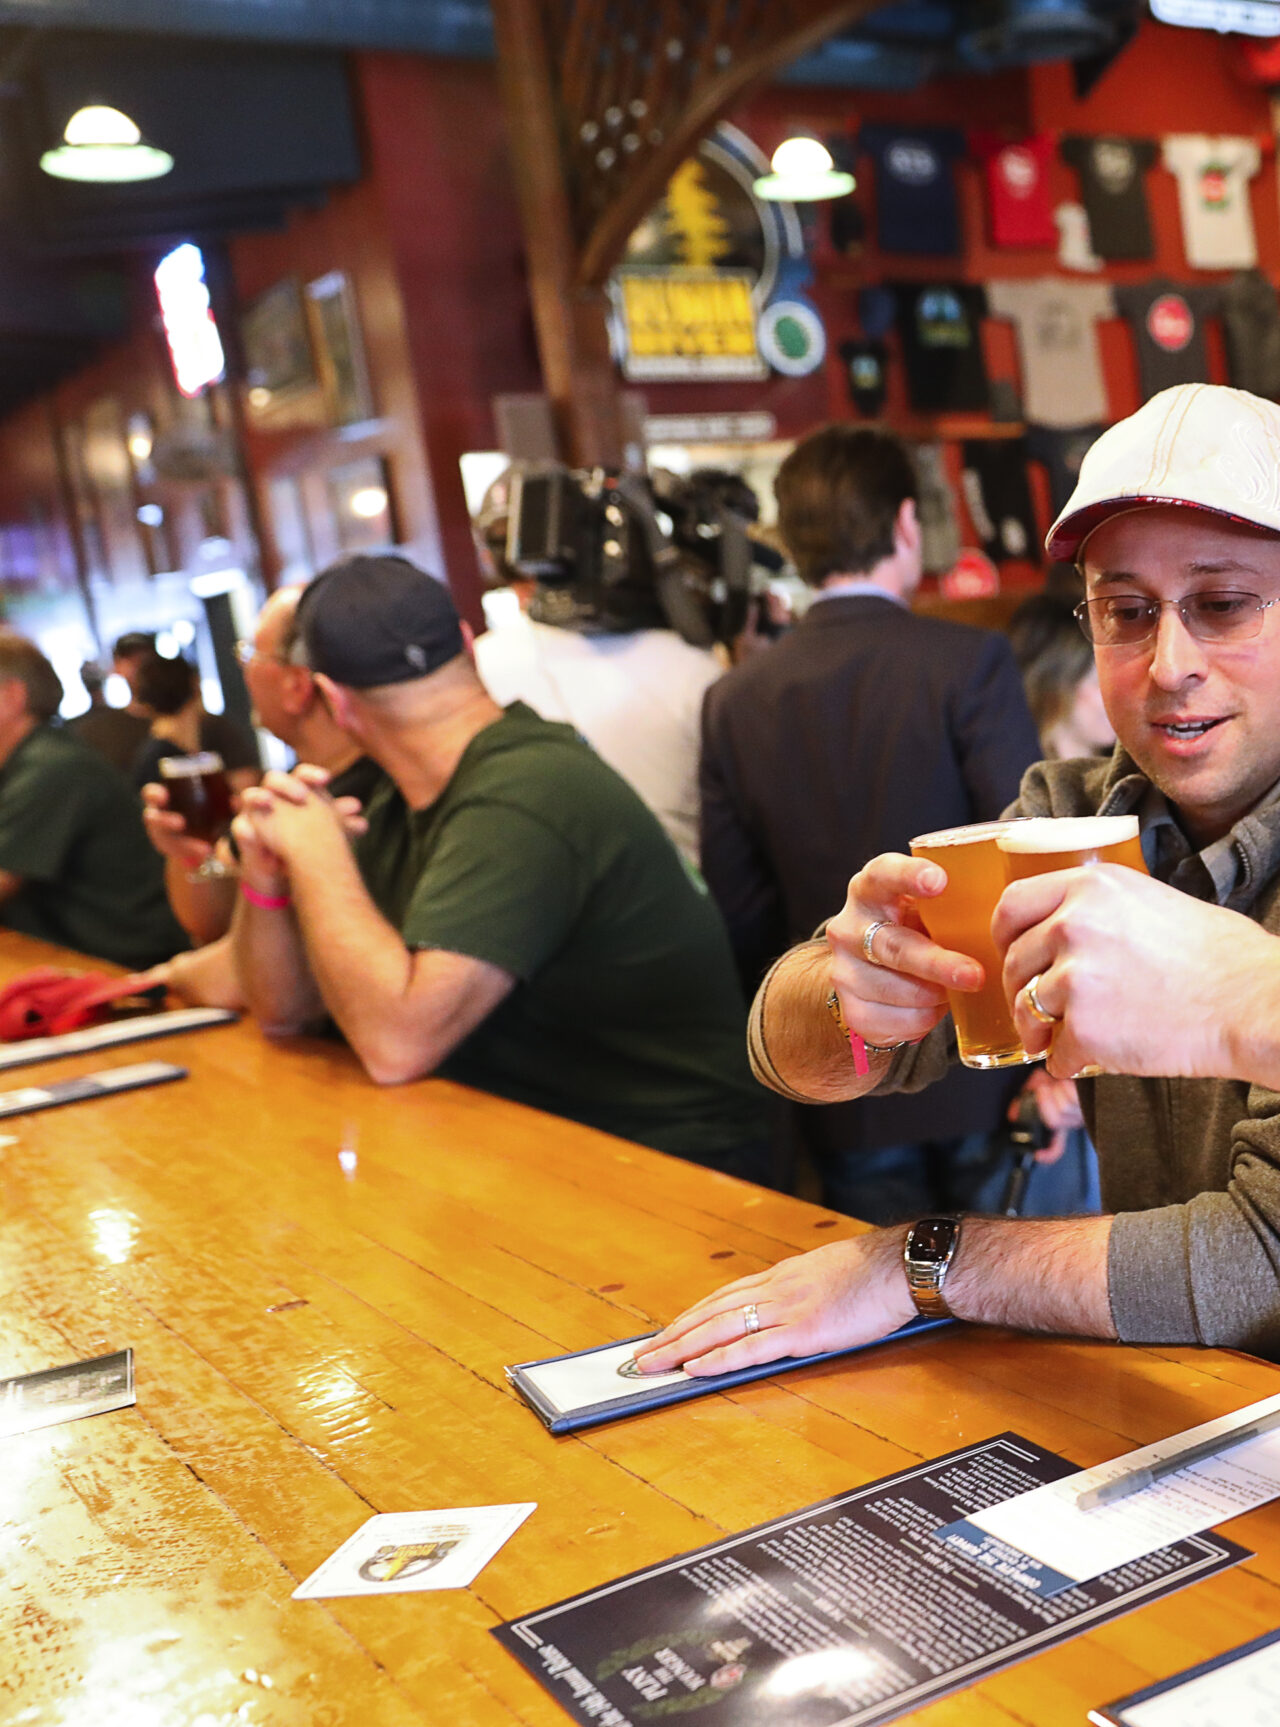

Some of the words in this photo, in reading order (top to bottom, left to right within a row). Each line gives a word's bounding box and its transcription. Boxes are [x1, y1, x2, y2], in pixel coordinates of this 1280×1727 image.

[979, 1552, 997, 1565] THE
[554, 1665, 595, 1697] Annual
[621, 1663, 666, 1701] PLINY
[652, 1647, 706, 1691] YOUNGER
